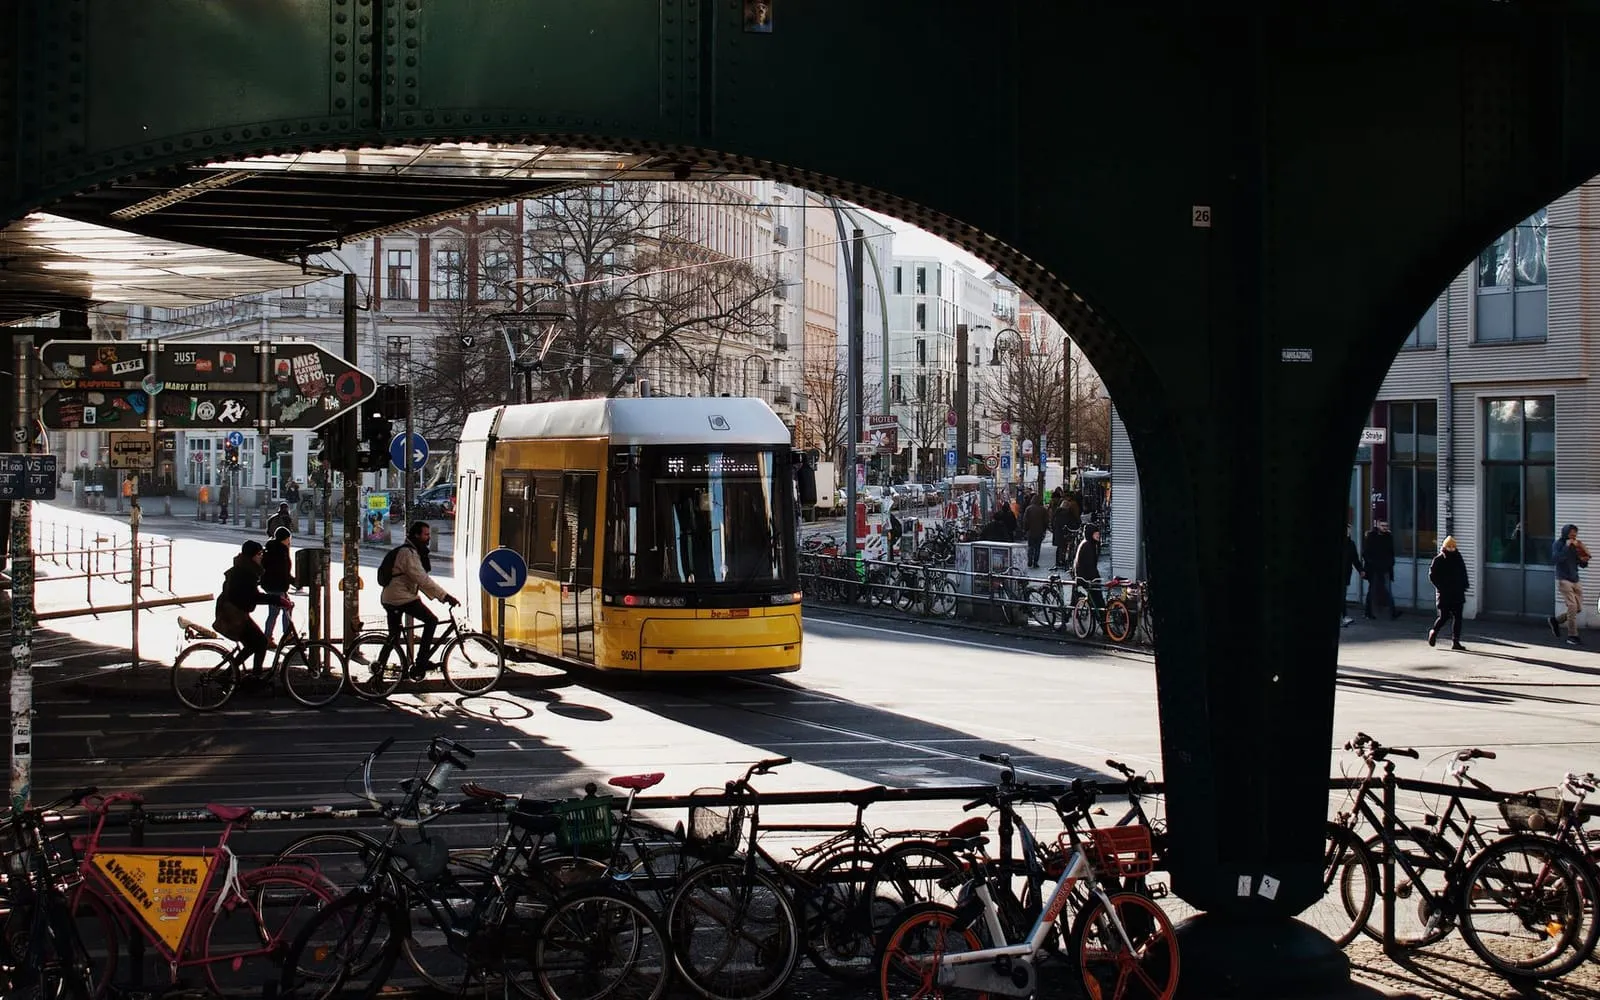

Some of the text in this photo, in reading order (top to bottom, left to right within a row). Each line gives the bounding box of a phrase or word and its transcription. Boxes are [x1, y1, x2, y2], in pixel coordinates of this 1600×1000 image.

[1195, 210, 1209, 222] 26
[174, 352, 196, 362] JUST
[292, 352, 320, 369] MISS
[190, 383, 207, 391] ARTS
[1, 460, 8, 470] H
[26, 461, 41, 471] VS
[621, 650, 637, 660] 9051
[159, 860, 182, 868] DER
[158, 876, 197, 884] WEGEN
